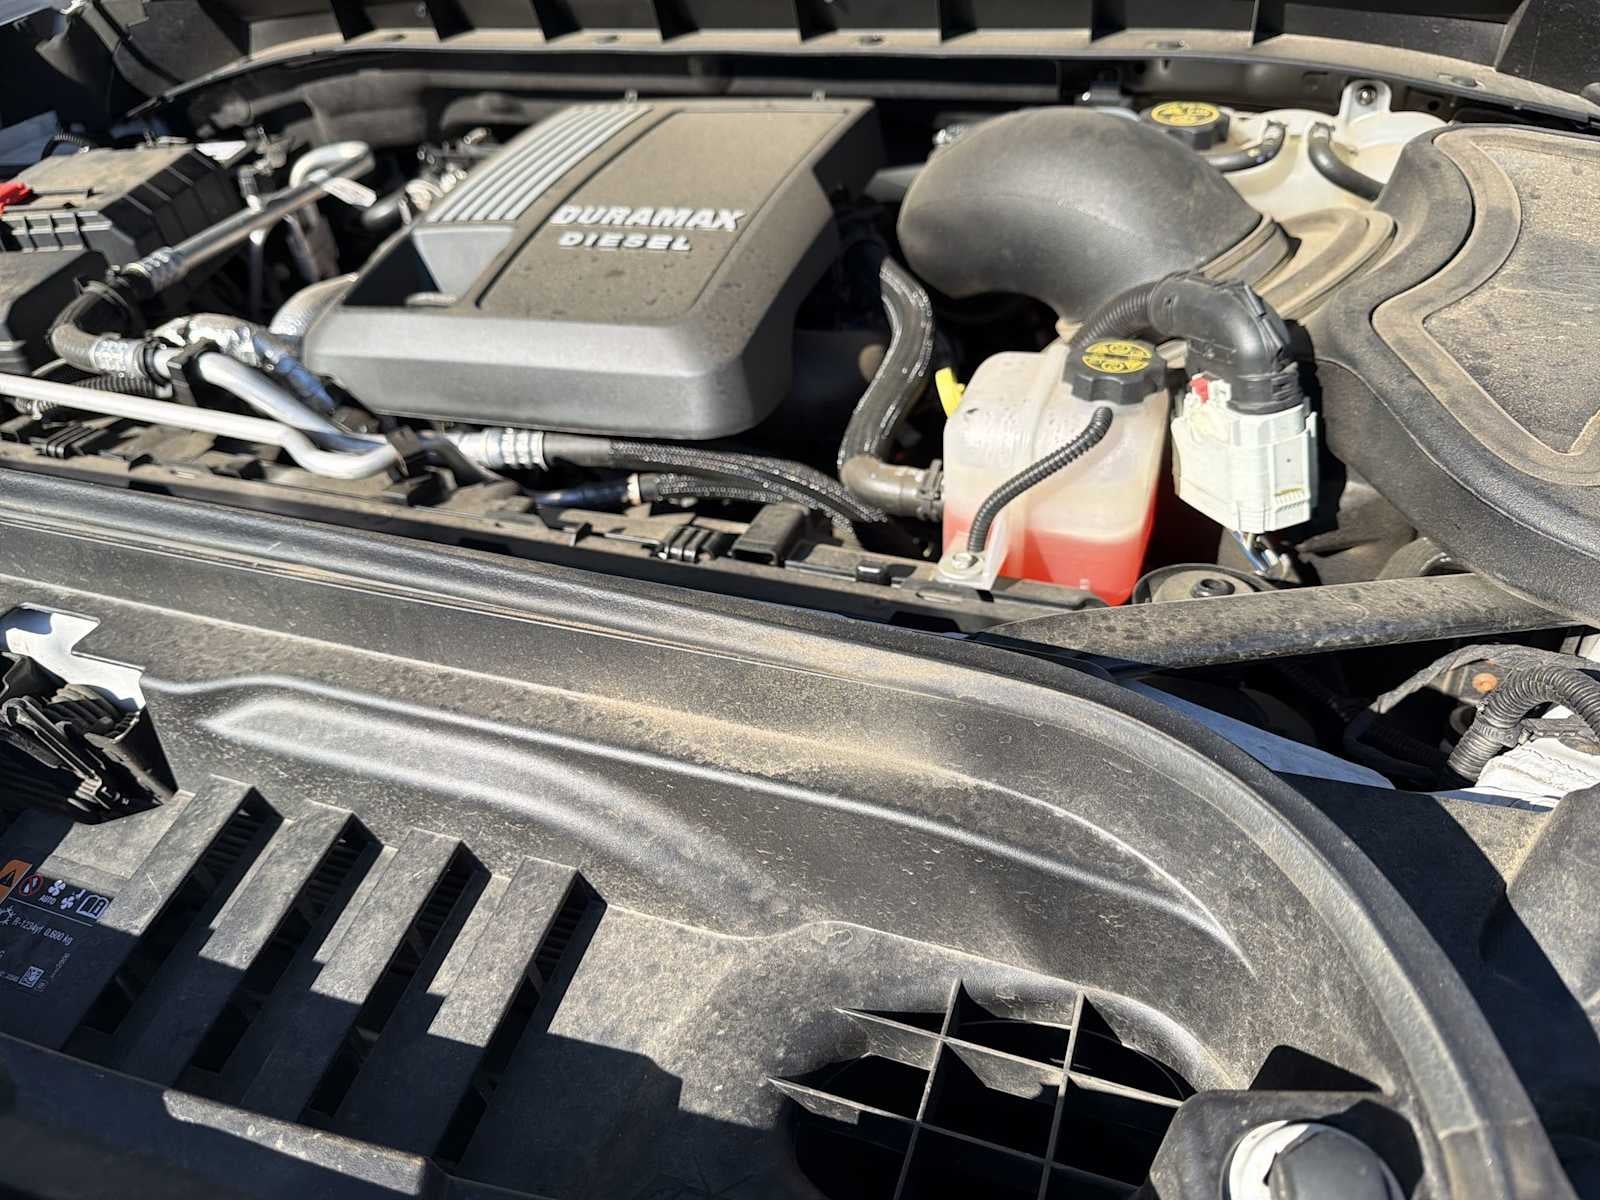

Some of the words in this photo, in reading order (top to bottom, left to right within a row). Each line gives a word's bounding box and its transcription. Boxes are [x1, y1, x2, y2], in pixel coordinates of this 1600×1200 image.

[551, 205, 746, 232] DURAMAX
[560, 231, 692, 251] DIESEL
[44, 927, 65, 941] 0.600
[62, 934, 73, 946] kg
